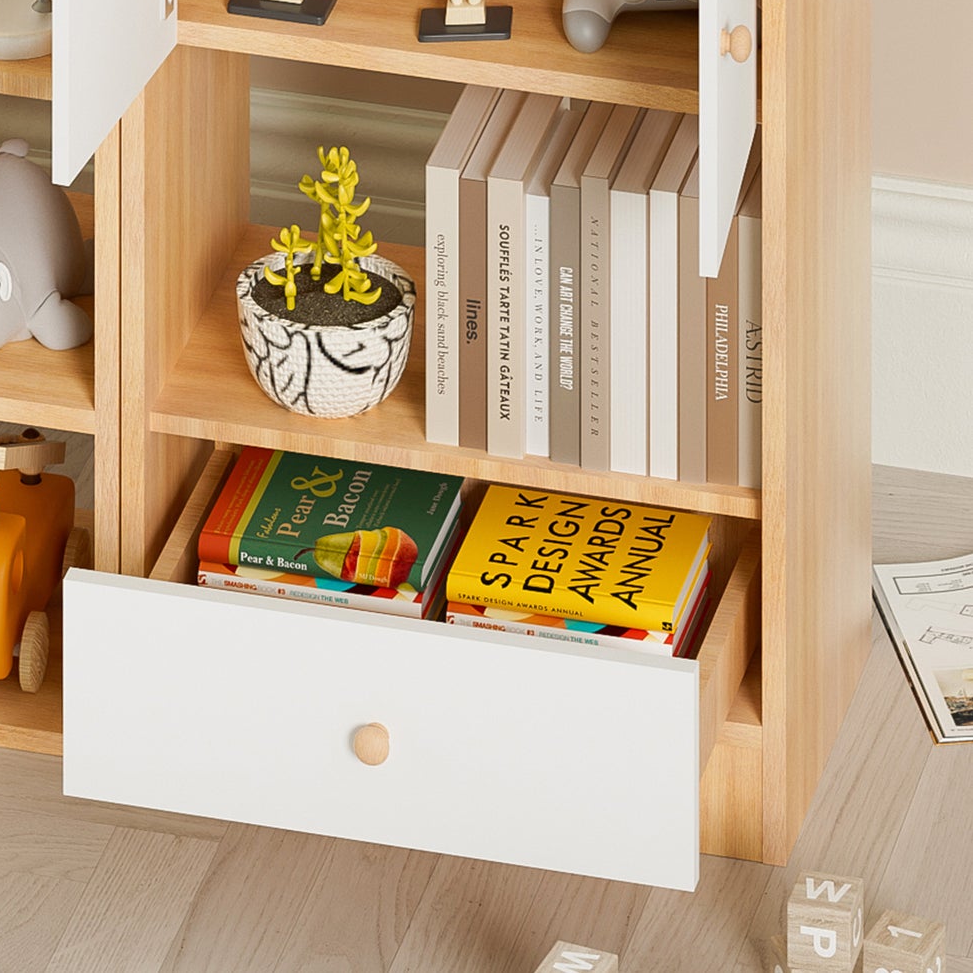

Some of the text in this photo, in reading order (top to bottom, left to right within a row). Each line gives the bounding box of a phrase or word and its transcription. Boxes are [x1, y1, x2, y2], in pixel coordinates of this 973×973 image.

[434, 234, 448, 395] exploring black sand beaches
[466, 298, 481, 344] lines.
[499, 224, 513, 420] SOUFFLÉS TARTE TATIN GÂTEAUX
[560, 267, 573, 390] CAN ART CHANGE THE WORLD?
[590, 216, 599, 436] NATIONAL BESTSELLER
[534, 352, 543, 381] AND
[714, 304, 728, 401] PHILADELPHIA
[534, 390, 543, 423] LIFE
[276, 465, 344, 538] Pear &
[322, 470, 372, 529] Bacon
[240, 551, 308, 571] Pear & Bacon
[480, 493, 549, 589] SPARK
[522, 500, 590, 594] DESIGN
[567, 506, 632, 604] AWARDS
[609, 514, 675, 611] ANNUAL
[224, 580, 257, 590] SMASHING
[457, 593, 584, 618] SPARK DESIGN AWARDS ANNUAL
[472, 621, 506, 632] SMASHING
[800, 925, 837, 958] P
